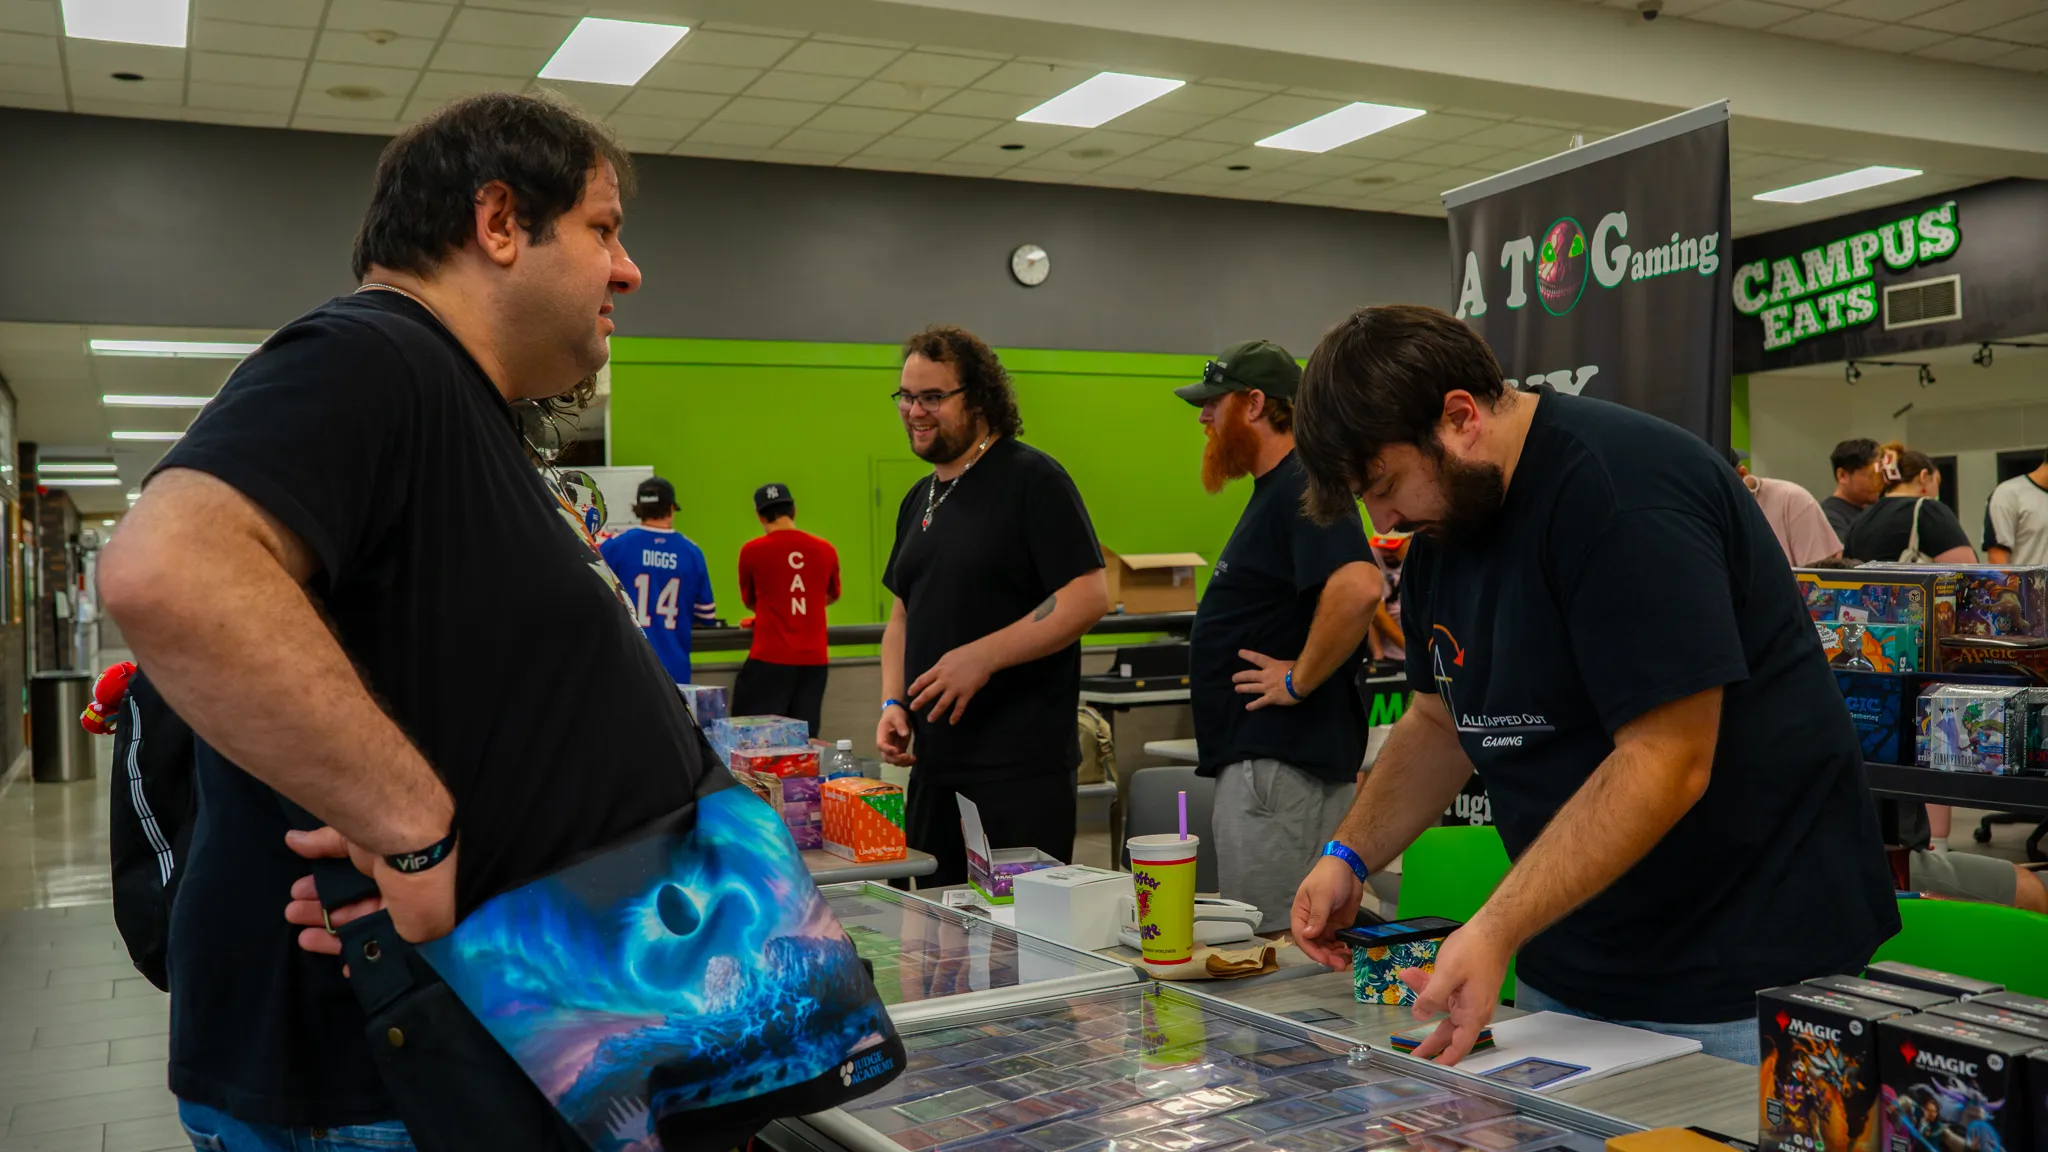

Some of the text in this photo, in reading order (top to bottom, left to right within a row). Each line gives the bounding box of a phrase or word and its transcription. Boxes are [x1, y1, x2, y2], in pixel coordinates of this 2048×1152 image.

[1456, 209, 1721, 320] A T Gaming
[1733, 202, 1960, 314] CAMPUS
[1761, 281, 1878, 352] EATS
[641, 548, 678, 570] DIGGS
[787, 550, 807, 616] CAN
[633, 572, 681, 631] 14
[1959, 648, 2018, 664] MAGIC
[1368, 690, 1413, 728] M
[1482, 735, 1523, 748] GAMING
[1788, 1017, 1842, 1042] MAGIC
[851, 1056, 896, 1085] ACADEMY
[853, 1050, 884, 1073] JUDGE
[1915, 1049, 1979, 1078] MAGIC
